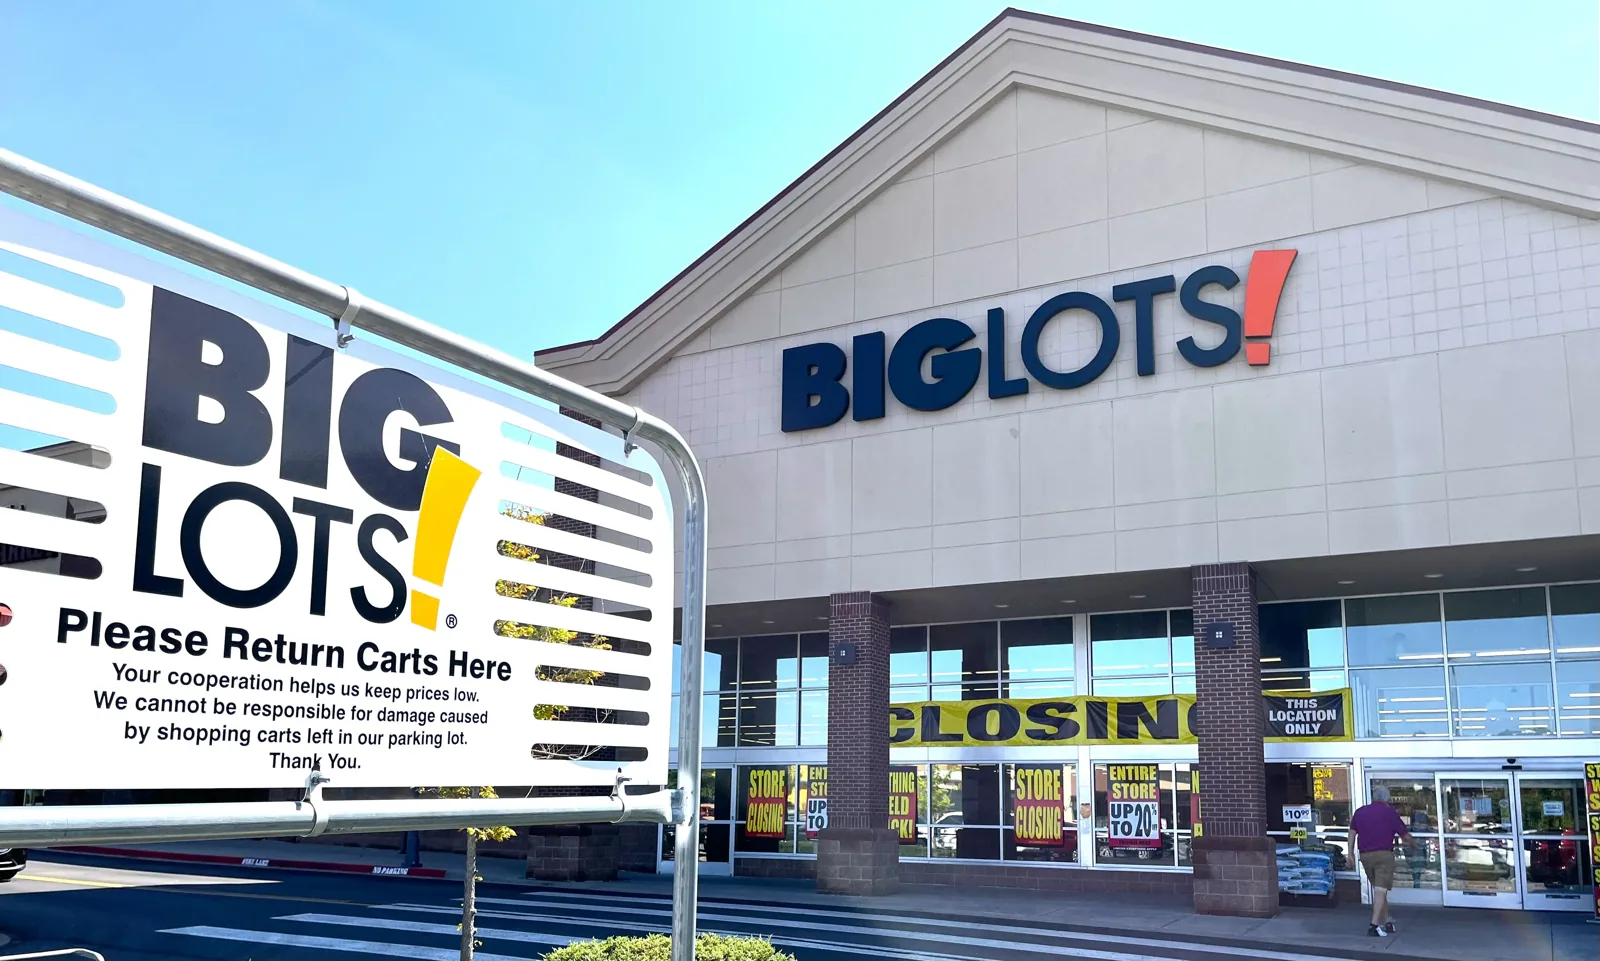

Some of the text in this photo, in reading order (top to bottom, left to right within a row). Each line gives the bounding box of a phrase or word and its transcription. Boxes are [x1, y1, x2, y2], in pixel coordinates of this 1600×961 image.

[142, 285, 461, 512] BIG
[133, 445, 482, 632] LOTS!
[57, 607, 512, 681] Please Return Carts Here
[112, 662, 480, 703] Your cooperation helps us keep prices low.
[93, 690, 488, 726] We cannot be responsible for damage caused
[1285, 698, 1318, 709] THIS
[890, 700, 1199, 742] CLOSIN
[1269, 709, 1337, 722] LOCATION
[124, 721, 468, 749] by shopping carts left in our parking lot.
[1285, 723, 1321, 735] ONLY
[269, 752, 361, 769] Thank You.
[1109, 765, 1157, 781] ENTIRE
[750, 769, 786, 799] STORE
[1016, 768, 1061, 801] STORE
[1112, 782, 1157, 800] STORE
[808, 801, 826, 814] UP
[889, 796, 910, 816] ELD
[1110, 803, 1134, 818] UP
[747, 803, 783, 834] CLOSING
[808, 816, 825, 830] TO
[1015, 805, 1061, 840] CLOSING
[1110, 820, 1133, 837] TO
[381, 867, 409, 876] PARKING
